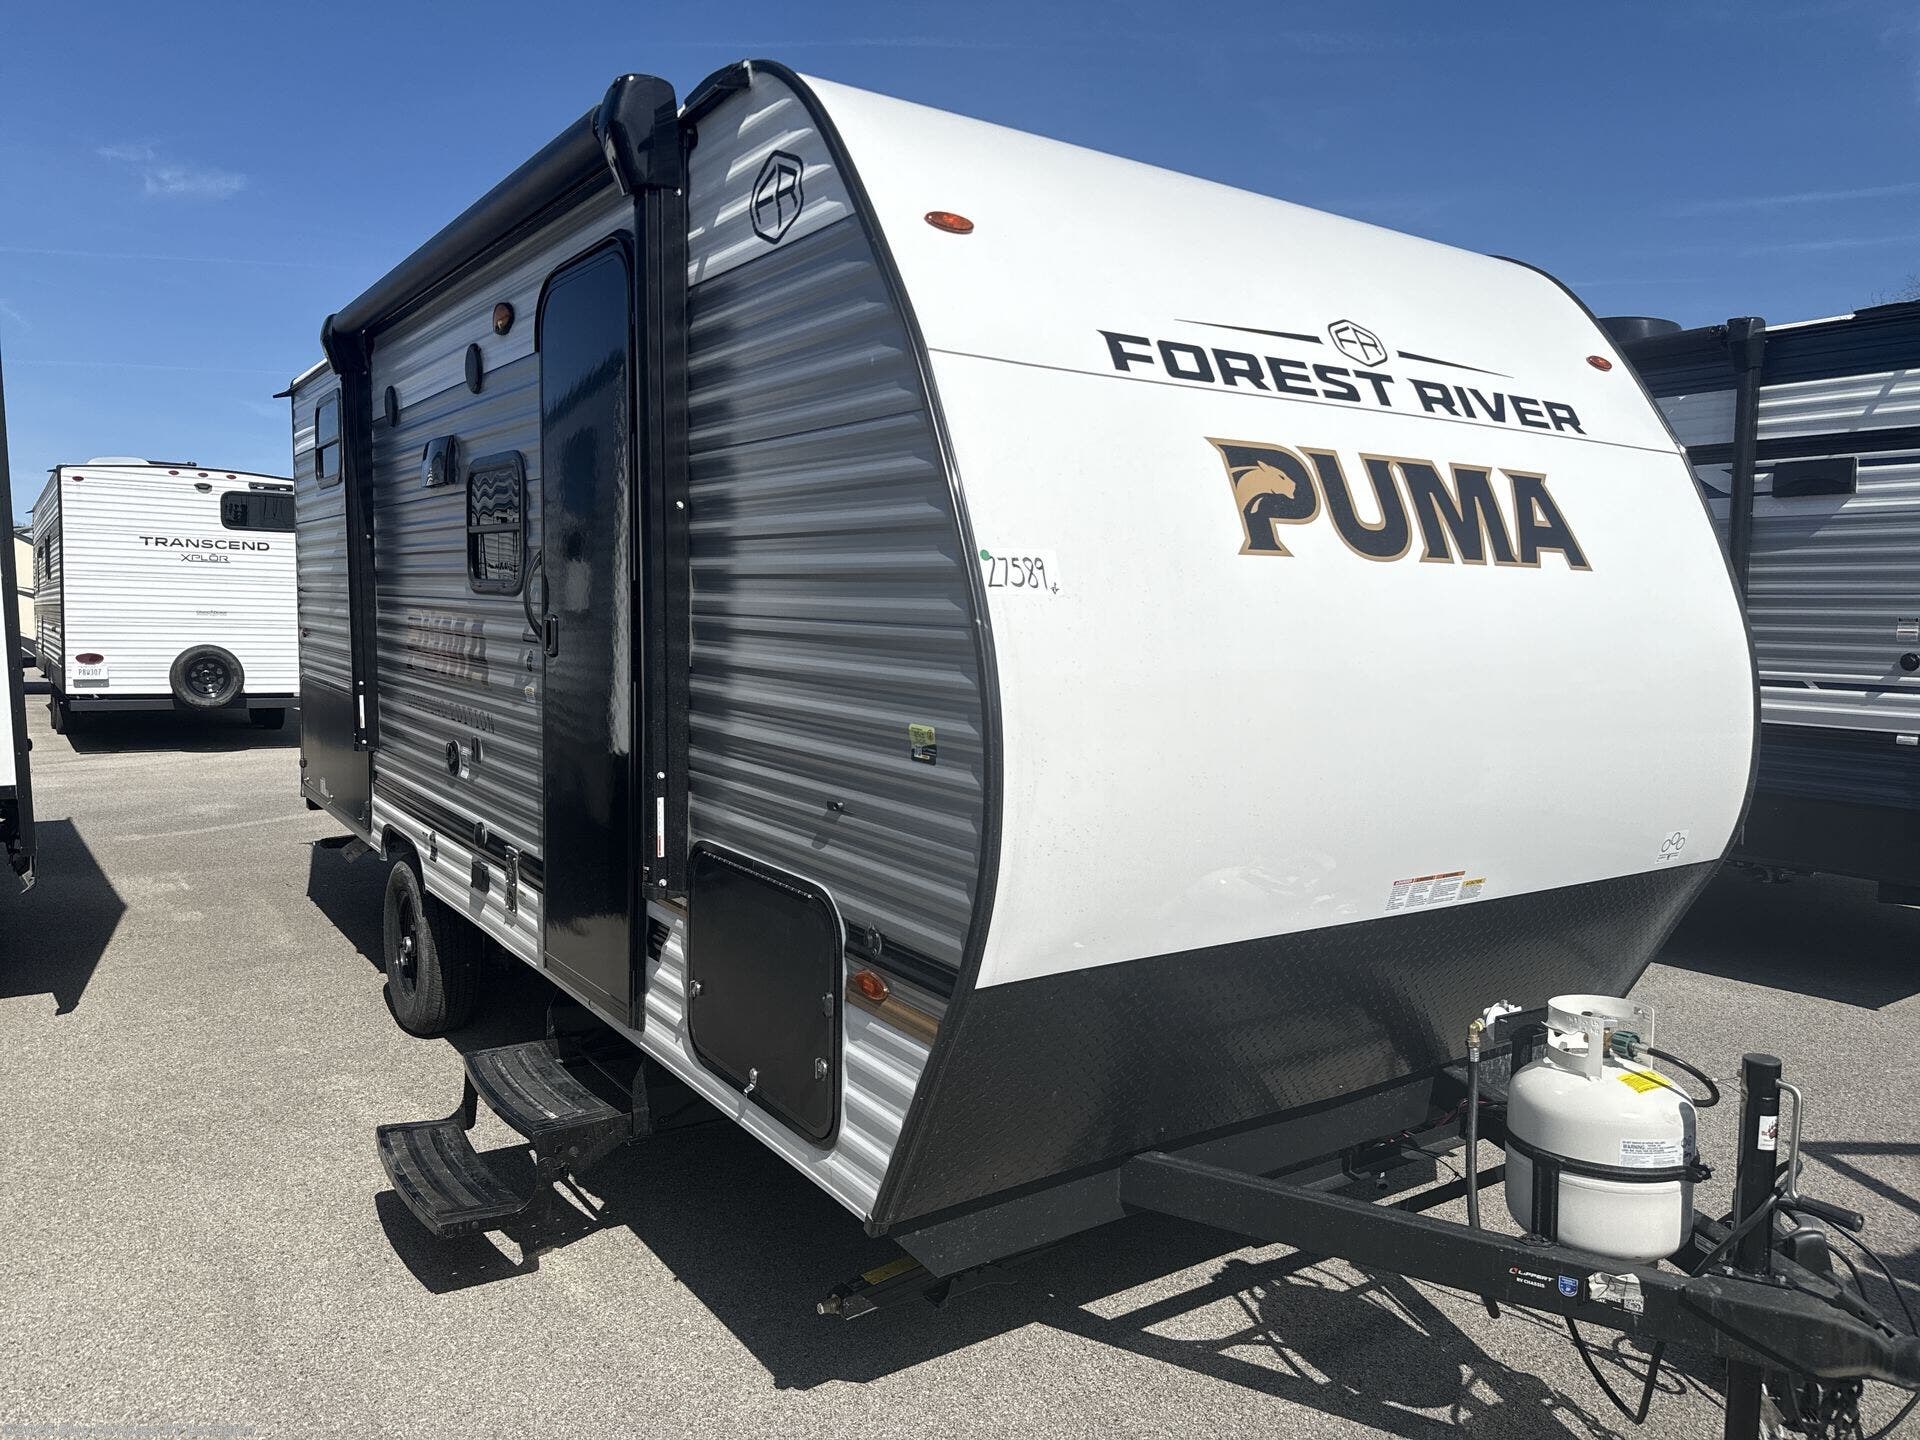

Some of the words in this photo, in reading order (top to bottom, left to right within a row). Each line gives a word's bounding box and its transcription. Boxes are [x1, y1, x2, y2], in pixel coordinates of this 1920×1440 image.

[1096, 329, 1395, 407] FOREST
[1407, 378, 1587, 435] RIVER
[1204, 436, 1593, 572] PUMA
[139, 535, 270, 551] TRANSCEND
[988, 556, 1048, 591] 27589
